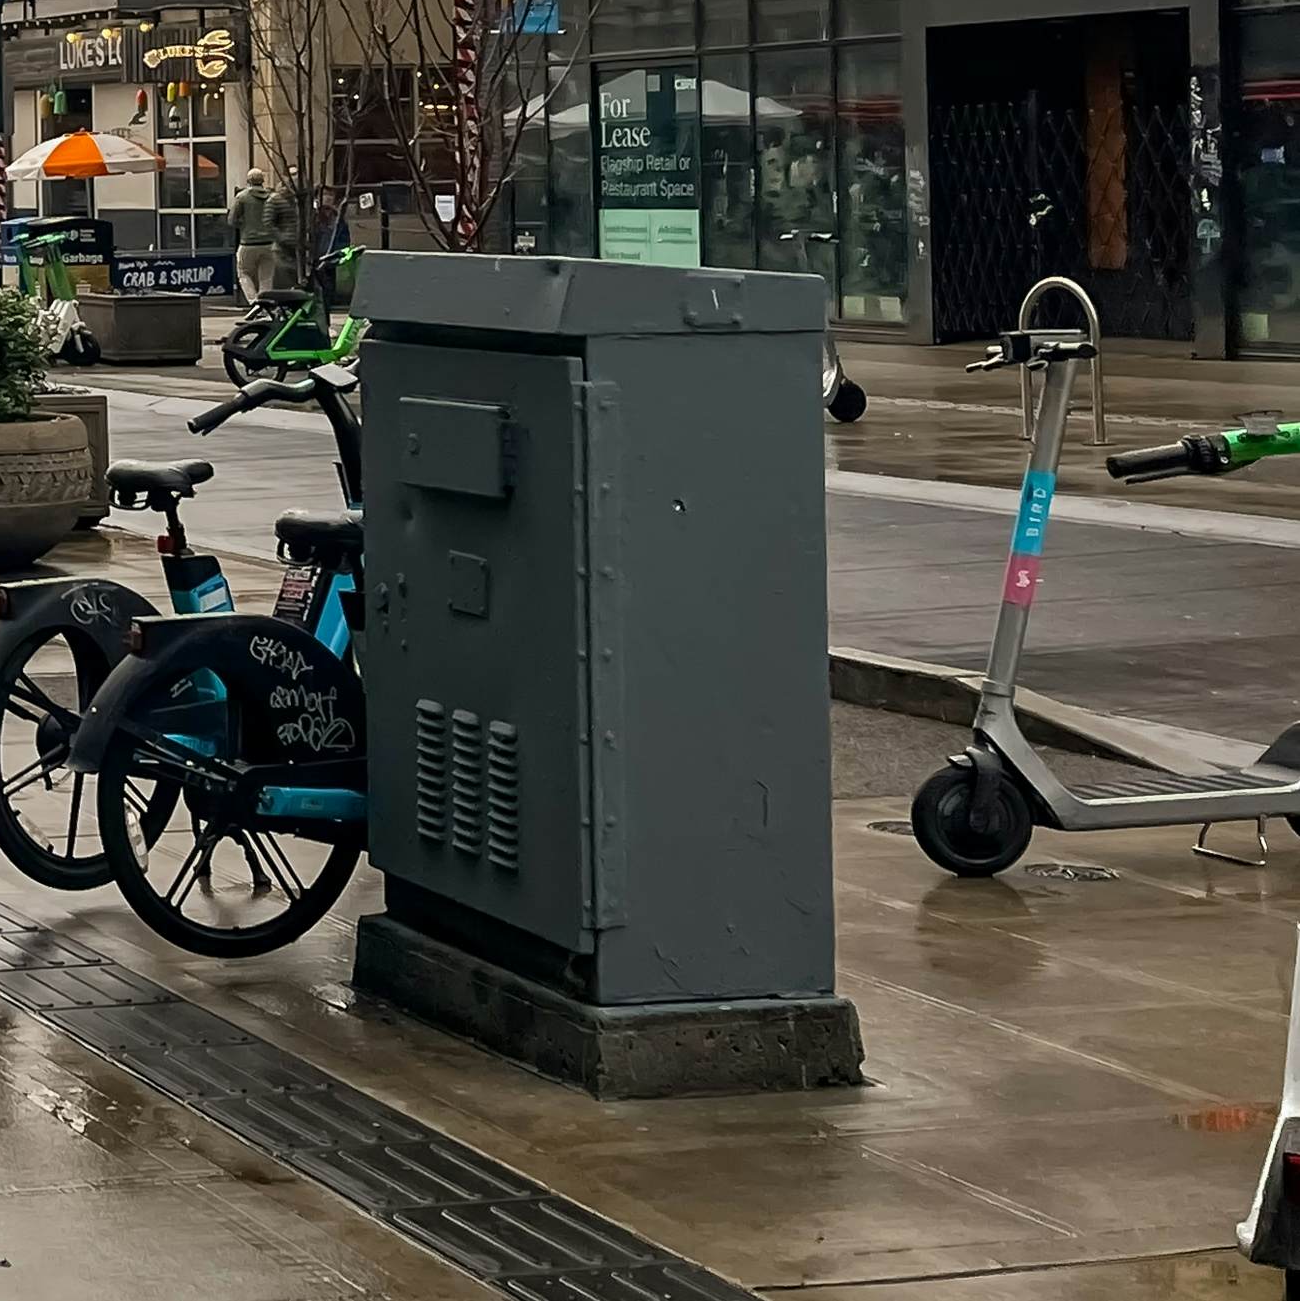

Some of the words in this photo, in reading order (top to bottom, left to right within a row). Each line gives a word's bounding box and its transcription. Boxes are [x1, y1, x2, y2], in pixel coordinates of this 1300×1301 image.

[59, 37, 105, 70] LUKE'S
[157, 45, 203, 64] LUKE'S
[600, 92, 631, 119] For
[600, 121, 651, 148] Lease
[600, 155, 643, 175] Flagship
[645, 154, 677, 171] Retail
[679, 156, 691, 171] or
[601, 180, 657, 198] Restaurant
[660, 179, 694, 199] Space
[61, 252, 104, 264] Garbage
[122, 270, 156, 287] CRAB
[158, 270, 168, 284] &
[170, 265, 215, 285] SHRIMP
[1025, 487, 1048, 537] BIRD
